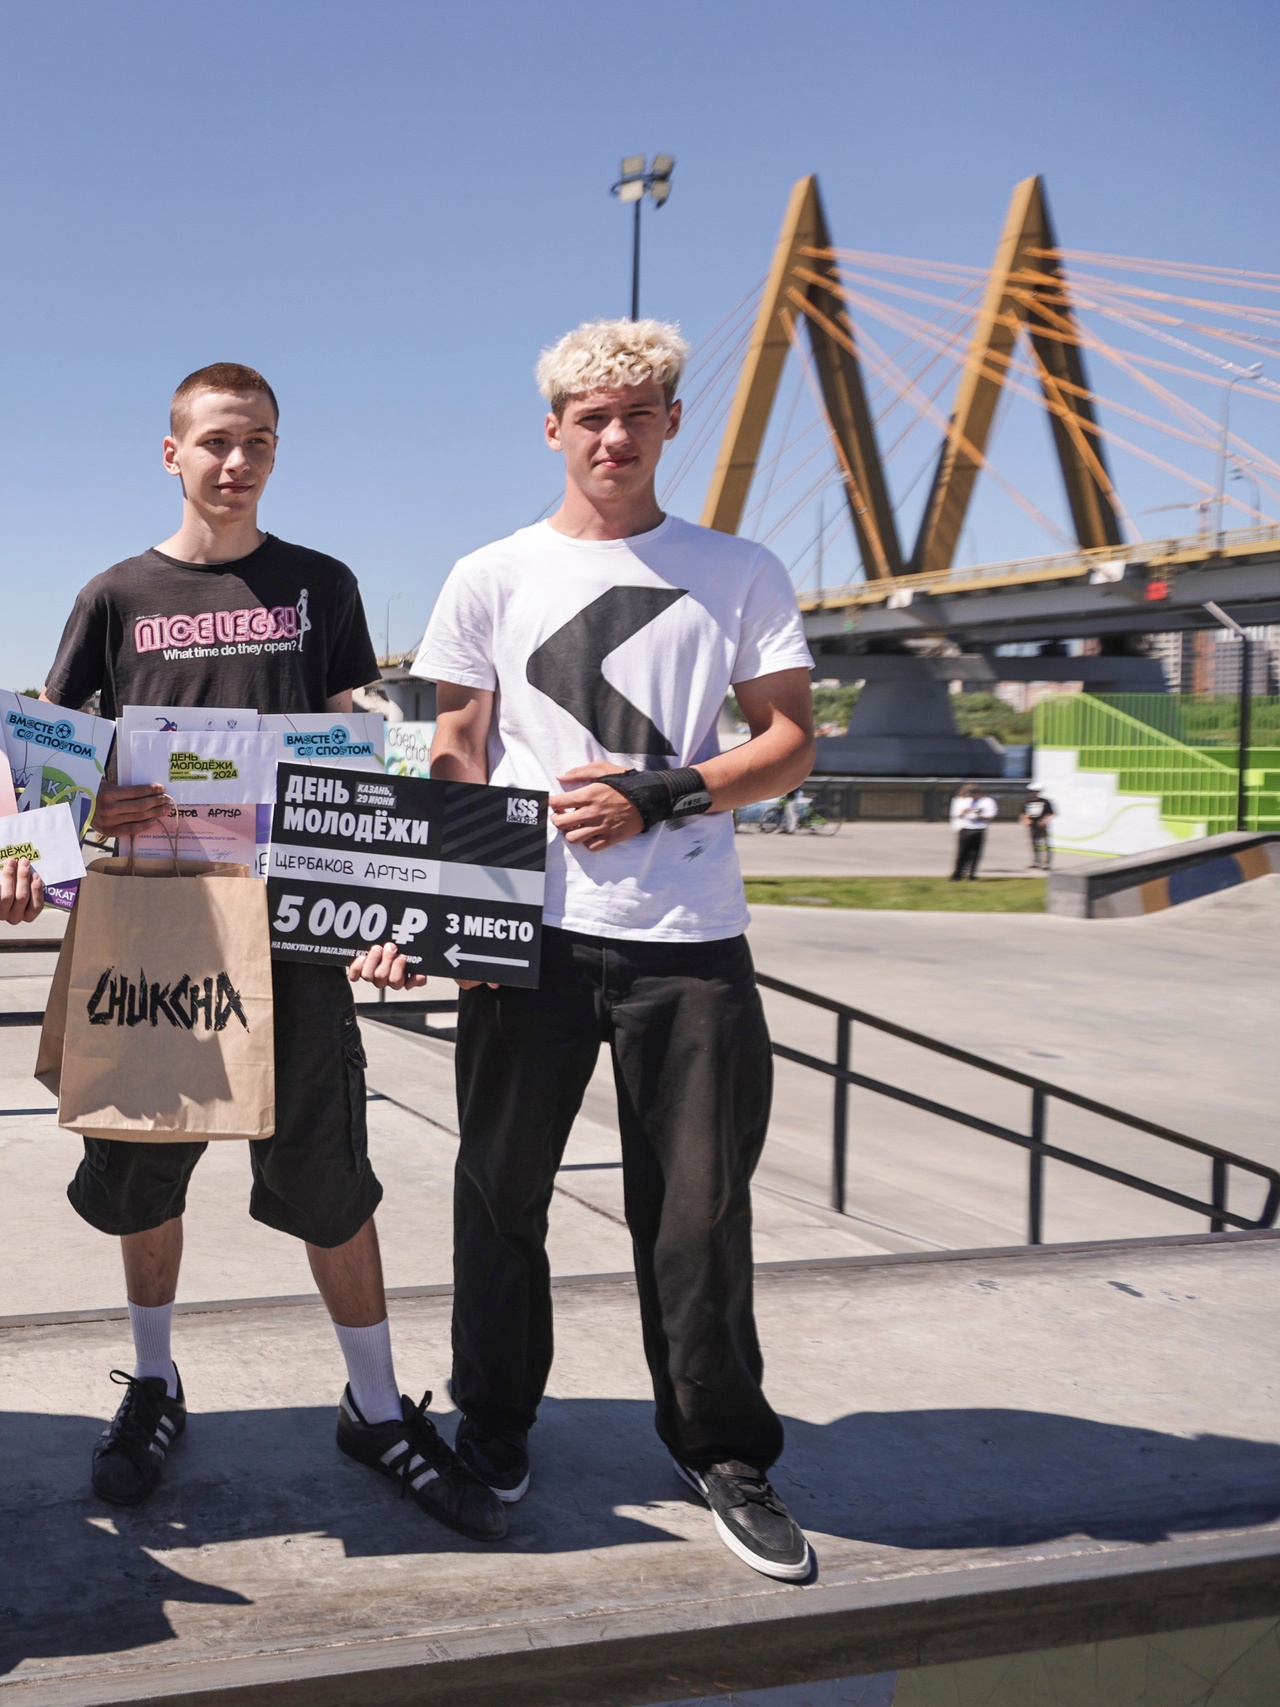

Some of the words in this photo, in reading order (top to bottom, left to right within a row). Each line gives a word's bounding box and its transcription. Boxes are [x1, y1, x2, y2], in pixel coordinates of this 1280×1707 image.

[163, 649, 194, 661] What
[194, 646, 219, 658] time
[221, 644, 236, 655] do
[237, 642, 264, 656] they
[264, 640, 297, 653] open?
[9, 714, 54, 734] ВМЕСТЕ
[17, 728, 33, 740] СО
[35, 734, 92, 757] СПОРТОМ
[287, 735, 330, 745] ВМЕСТЕ
[171, 753, 198, 762] ДЕНЬ
[297, 746, 313, 756] СО
[315, 745, 371, 756] СПОРТОМ
[171, 760, 233, 771] МОЛОДЁЖИ
[213, 770, 237, 780] 2024
[284, 775, 350, 805] ДЕНЬ
[357, 784, 393, 797] КАЗАНЬ,
[356, 794, 368, 804] 29
[368, 795, 395, 806] ИЮНЯ
[507, 798, 539, 818] KSS
[208, 808, 241, 818] АРТУР
[283, 806, 429, 845] МОЛОДЁЖИ
[275, 852, 354, 875] ЩЕРБАКОВ
[364, 862, 427, 883] АРТУР
[445, 914, 460, 934] 3
[464, 915, 534, 942] МЕСТО
[271, 941, 281, 949] НА
[281, 942, 314, 953] ПОКУПКУ
[320, 946, 356, 957] МАГАЗИНЕ
[87, 966, 250, 1033] CHUKCHA
